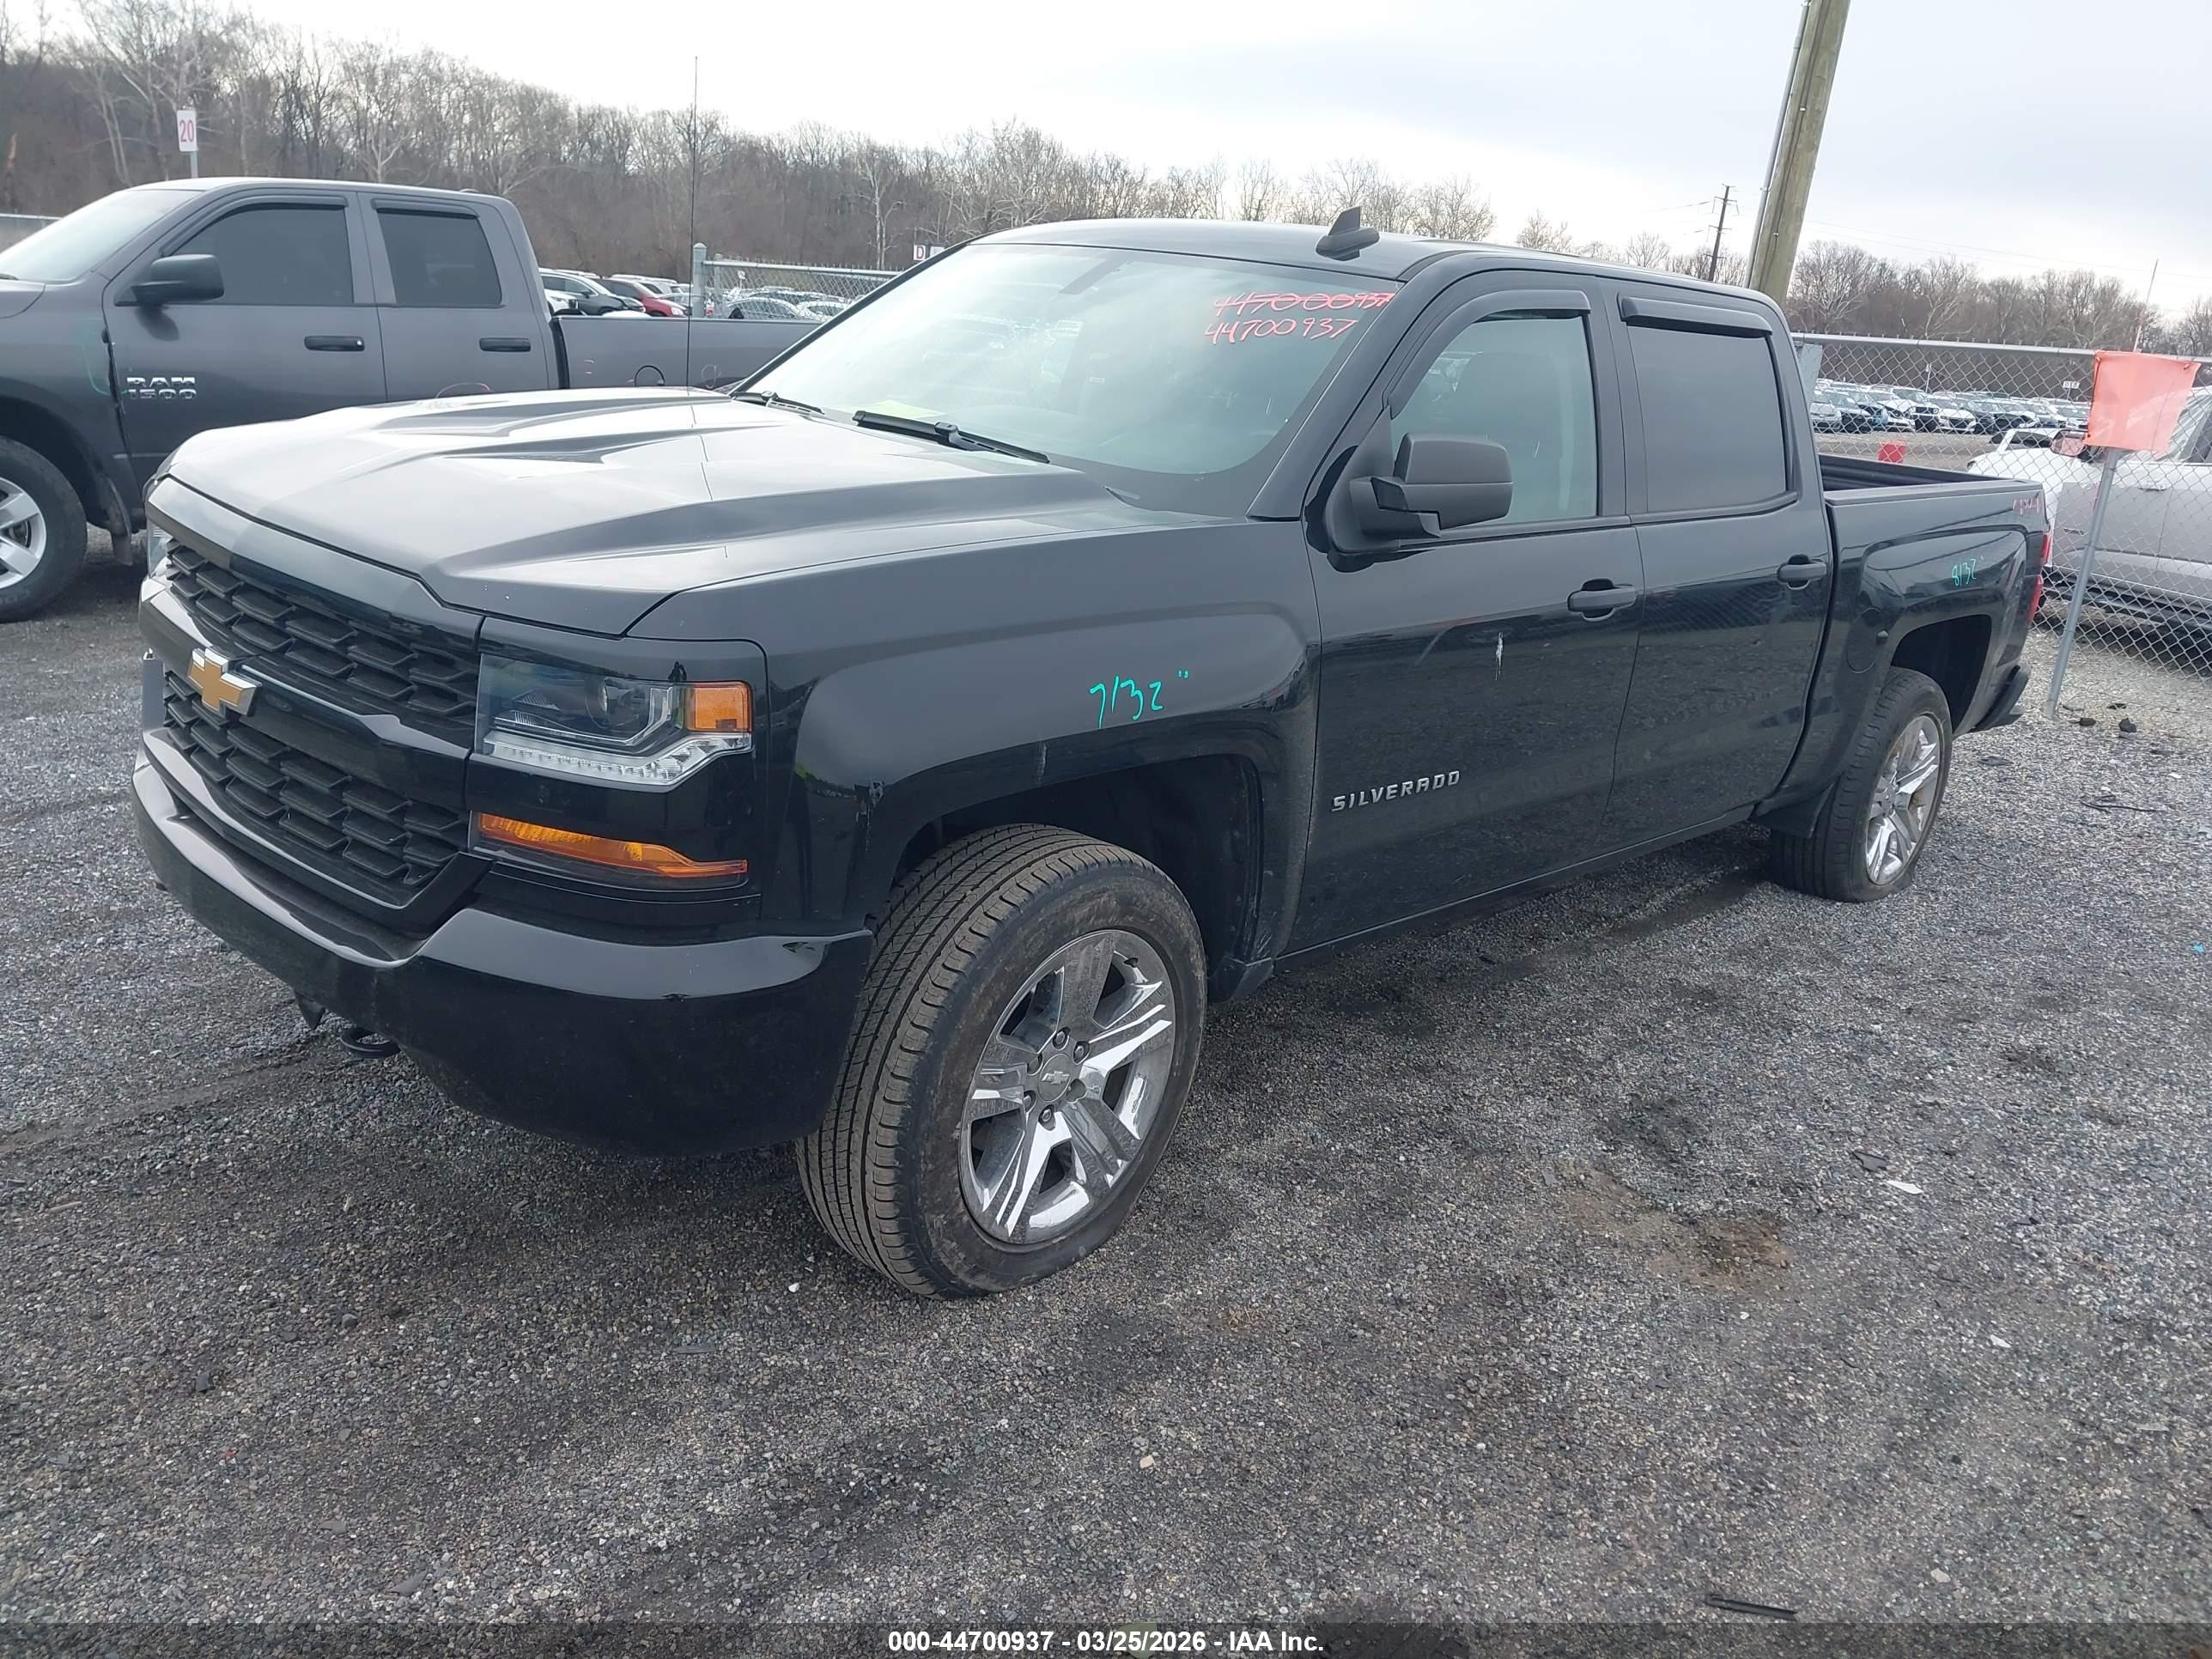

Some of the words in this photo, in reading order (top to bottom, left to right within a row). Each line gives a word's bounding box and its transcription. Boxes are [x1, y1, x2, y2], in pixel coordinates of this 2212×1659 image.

[179, 119, 195, 143] 20
[916, 246, 925, 259] D
[126, 377, 196, 388] RAM
[127, 388, 198, 399] 1500
[1331, 770, 1460, 811] SILVERADO
